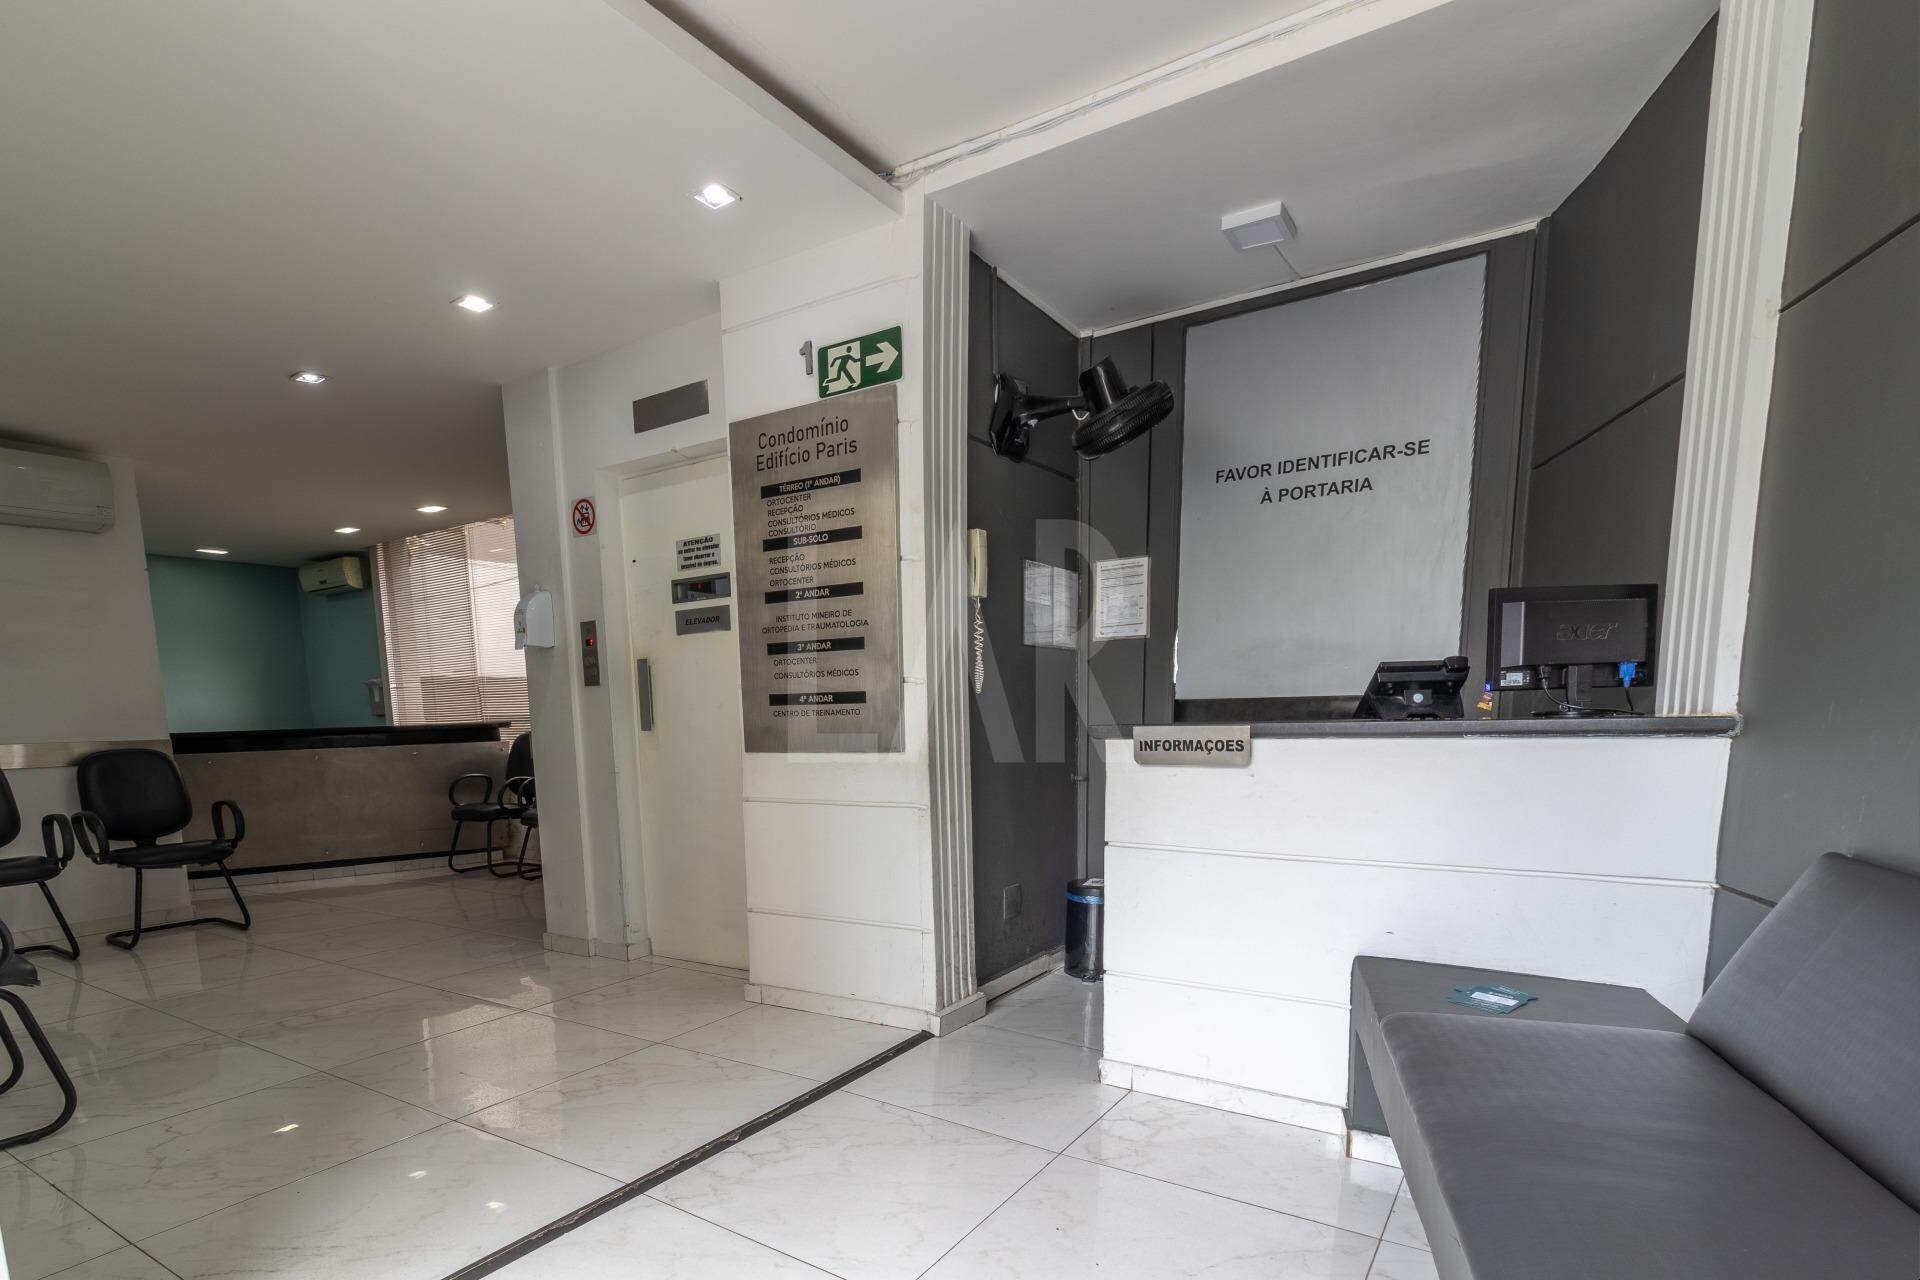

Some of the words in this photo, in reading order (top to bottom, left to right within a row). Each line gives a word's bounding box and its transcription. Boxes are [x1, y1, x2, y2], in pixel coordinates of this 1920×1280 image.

[799, 340, 813, 375] 1
[758, 417, 849, 450] Condomínio
[756, 446, 810, 472] Edifício
[816, 438, 858, 460] Paris
[1215, 463, 1272, 484] FAVOR
[1277, 439, 1431, 475] IDENTIFICAR-SE
[779, 481, 803, 494] TÉRREO
[813, 475, 841, 488] ANDAR)
[1260, 487, 1273, 504] À
[1278, 477, 1373, 502] PORTARIA
[766, 493, 812, 507] ORTOCENTER
[767, 504, 804, 518] RECEPÇÃO
[768, 512, 820, 528] CONSULTÓRIOS
[822, 507, 855, 518] MÉDICOS
[768, 523, 816, 537] CONSULTÓRIO
[793, 533, 829, 546] SUB-SOLO
[769, 553, 805, 565] RECEPÇÃO
[769, 562, 822, 576] CONSULTÓRIOS
[823, 558, 856, 570] MÉDICOS
[769, 576, 814, 587] ORTOCENTER
[804, 588, 830, 598] ANDAR
[685, 616, 720, 626] ELEVADOR
[775, 613, 810, 623] INSTITUTO
[811, 610, 840, 620] MINEIRO
[842, 609, 852, 618] DE
[762, 624, 799, 635] ORTOPEDIA
[801, 623, 806, 631] E
[806, 619, 869, 631] TRAUMATOLOGIA
[806, 641, 832, 650] ANDAR
[774, 656, 817, 667] ORTOCENTER
[774, 669, 825, 680] CONSULTÓRIOS
[826, 667, 859, 677] MÉDICOS
[808, 694, 834, 703] ANDAR
[773, 710, 800, 718] CENTRO
[801, 710, 811, 718] DE
[812, 708, 860, 717] TREINAMENTO
[1139, 739, 1245, 755] INFORMAÇOES
